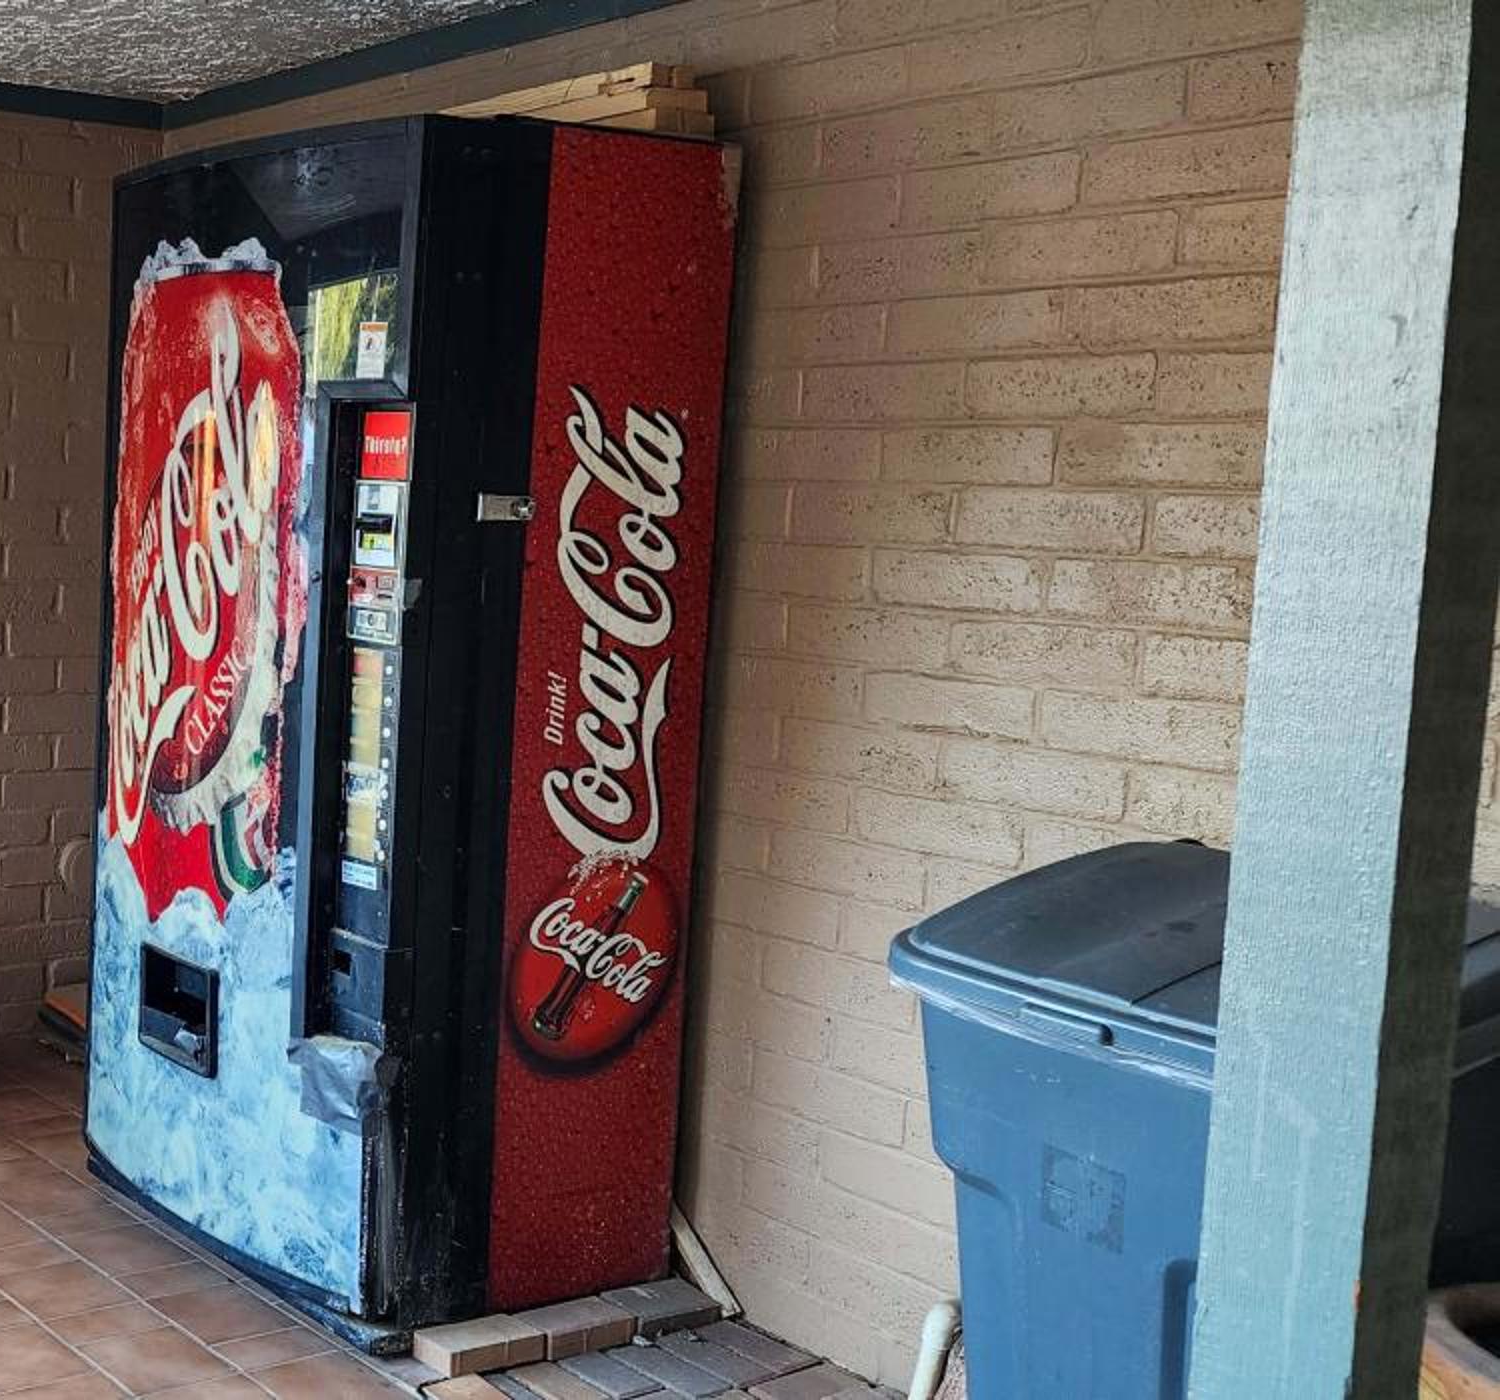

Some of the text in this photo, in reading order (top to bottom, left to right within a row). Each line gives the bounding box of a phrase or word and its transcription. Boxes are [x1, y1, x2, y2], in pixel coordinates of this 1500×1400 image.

[542, 385, 683, 862] Coca-Cola
[184, 636, 248, 755] CLASSIC
[544, 671, 567, 745] Drink!
[530, 898, 667, 1003] Coca-Cola
